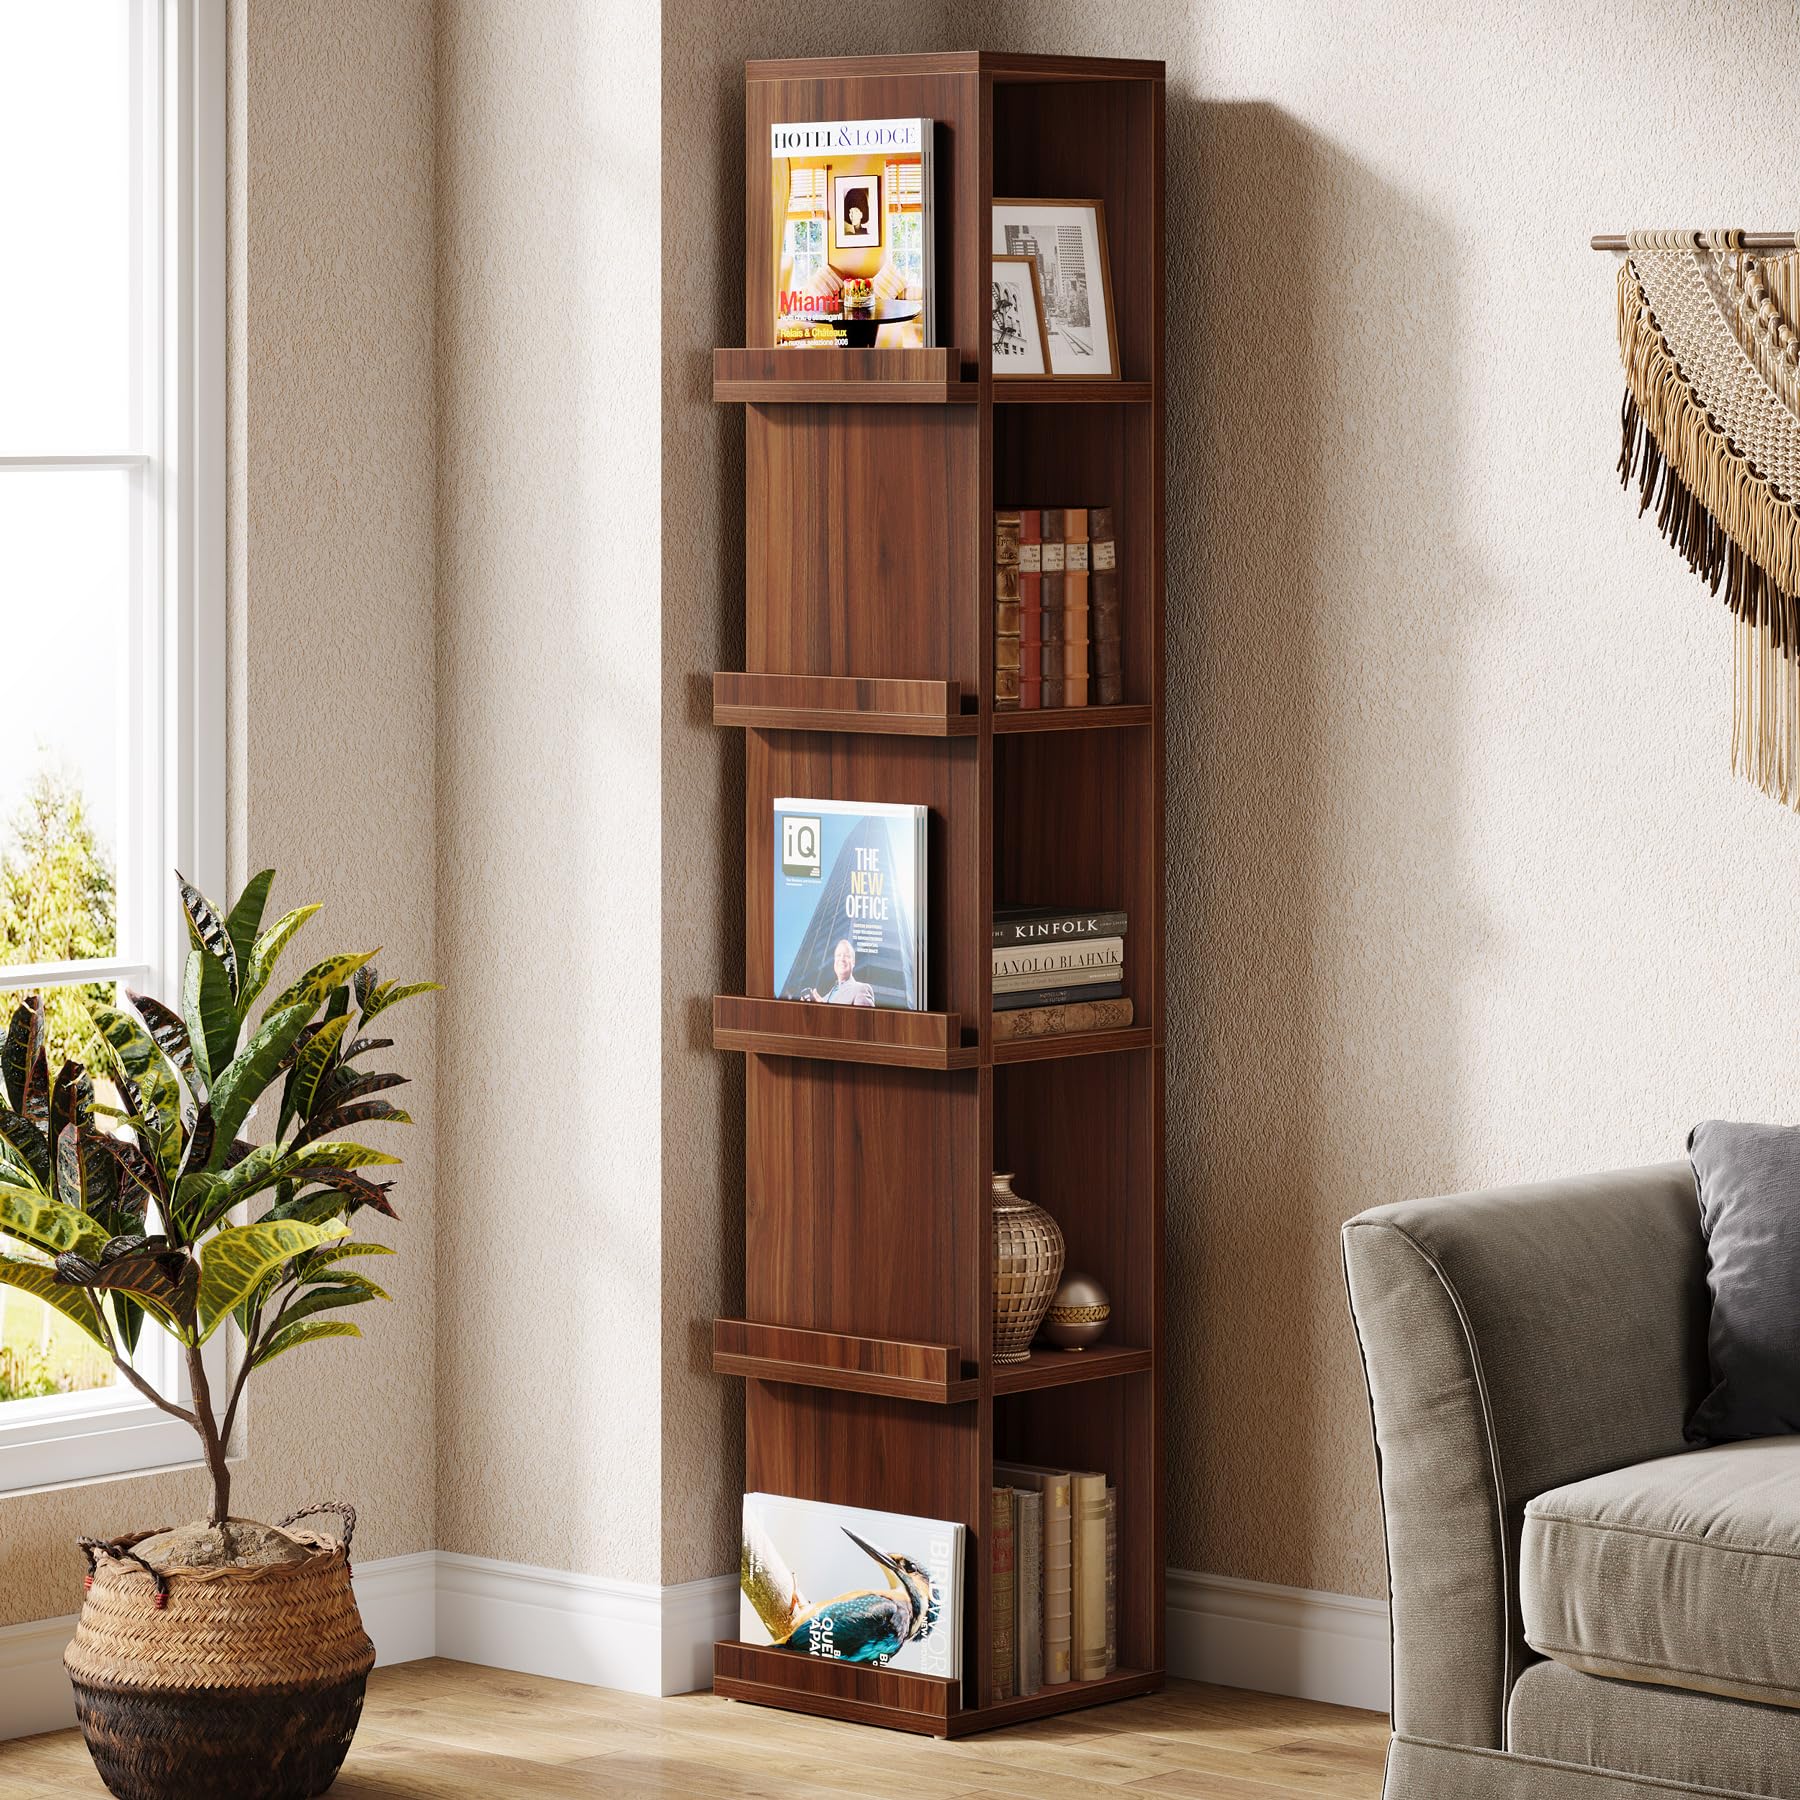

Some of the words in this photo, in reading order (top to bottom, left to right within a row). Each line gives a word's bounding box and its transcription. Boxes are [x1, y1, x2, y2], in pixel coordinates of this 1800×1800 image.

[780, 290, 839, 313] Miami
[780, 328, 803, 338] Relais
[804, 328, 811, 338] &
[788, 825, 816, 858] iQ
[855, 847, 879, 871] THE
[851, 871, 884, 896] NEW
[845, 895, 889, 920] OFFICE
[1015, 919, 1098, 938] KINFOLK
